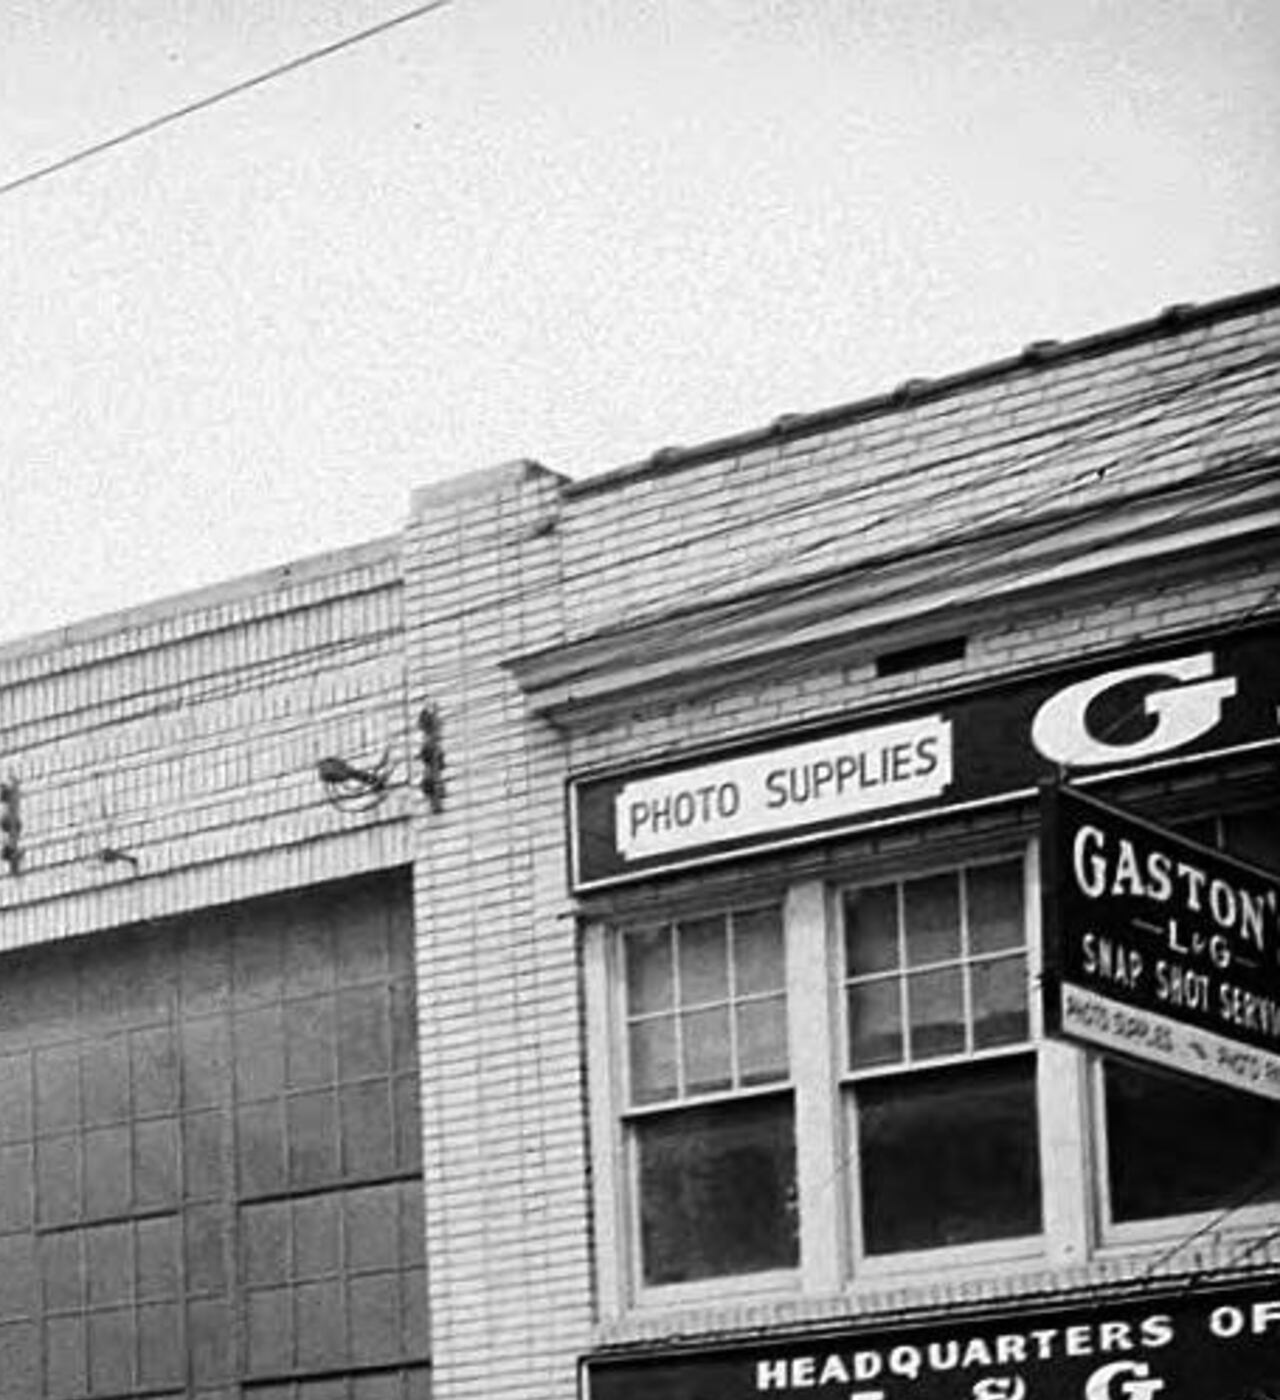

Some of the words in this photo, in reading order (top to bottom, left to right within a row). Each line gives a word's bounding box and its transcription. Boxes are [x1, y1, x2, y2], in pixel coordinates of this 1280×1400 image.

[1031, 651, 1280, 768] G
[629, 781, 740, 839] PHOTO
[765, 736, 939, 809] SUPPLIES
[1073, 824, 1280, 967] GASTON'
[1168, 918, 1189, 954] L
[1209, 934, 1231, 968] G
[1081, 932, 1143, 990] SNAP
[1154, 960, 1209, 1012] SHOT
[756, 1314, 1174, 1391] HEADQUARTERS
[1209, 1301, 1280, 1338] OF
